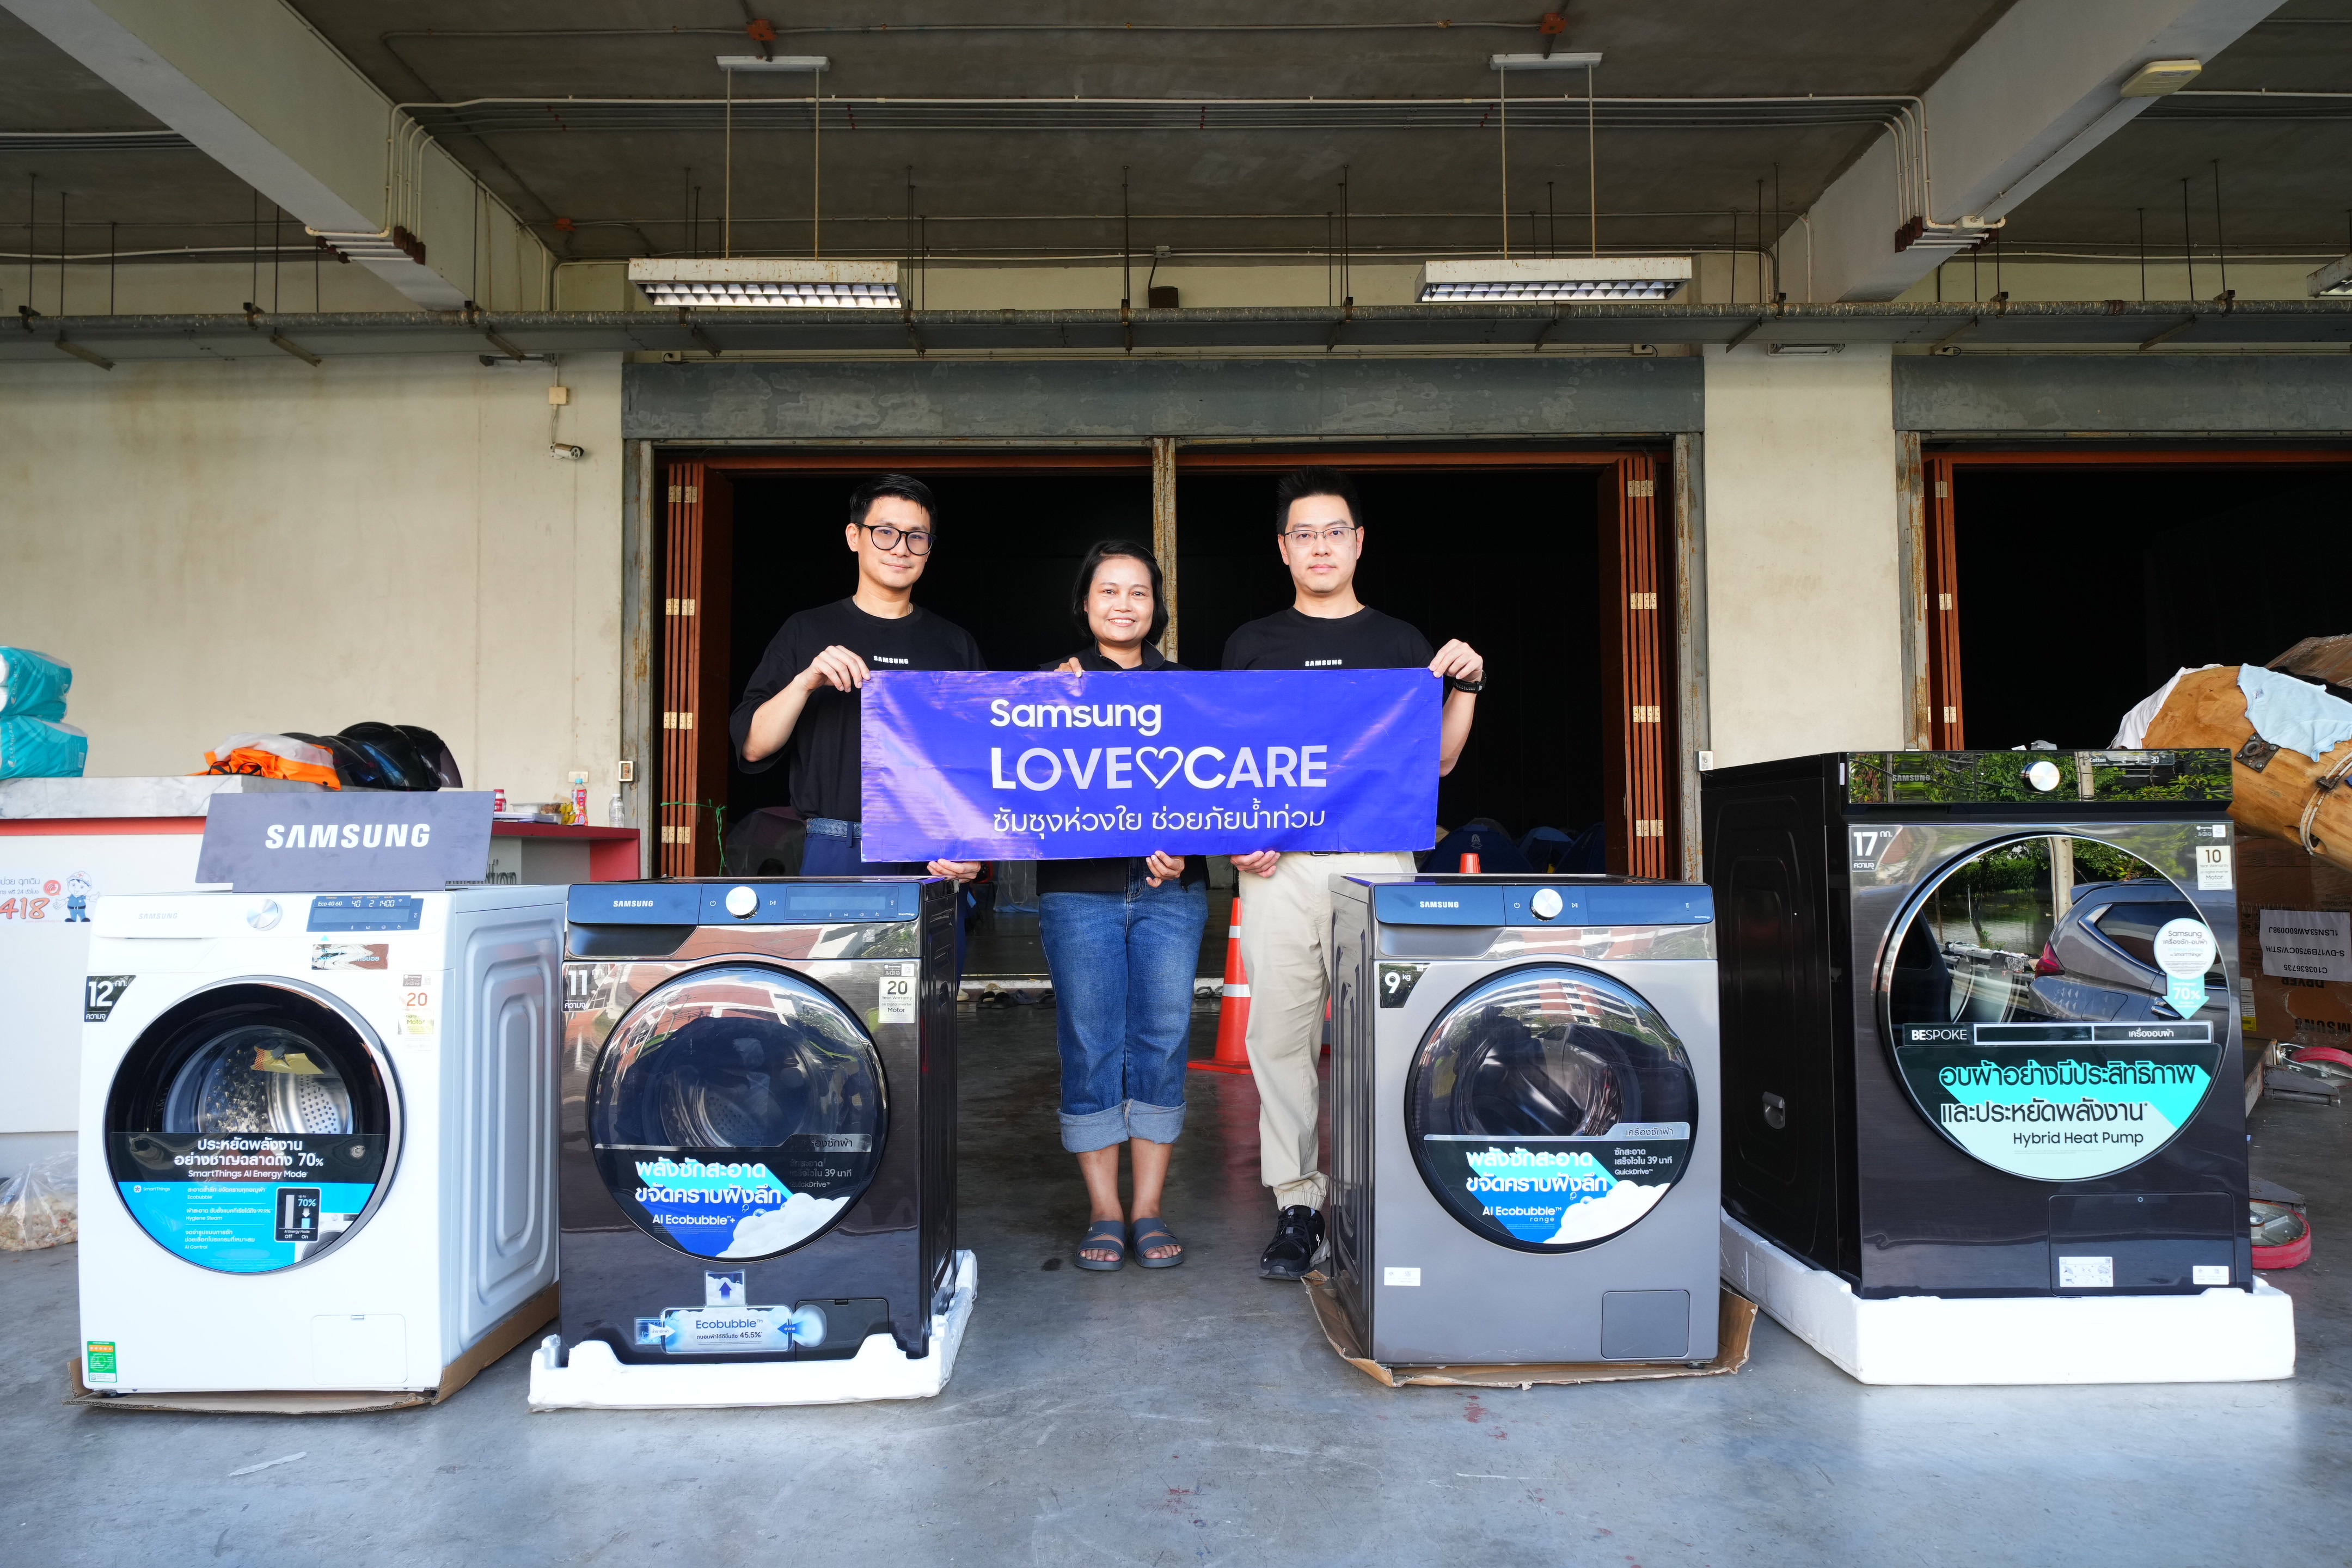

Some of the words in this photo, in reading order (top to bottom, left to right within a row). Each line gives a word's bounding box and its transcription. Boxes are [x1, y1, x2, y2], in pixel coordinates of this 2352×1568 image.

[873, 656, 909, 664] SAMSUNG
[990, 699, 1161, 737] Samsung
[991, 746, 1132, 792] LOVE
[1184, 745, 1327, 789] CARE
[994, 805, 1142, 839] ซัมซุงห่วงใย
[1152, 798, 1325, 831] ช่วยภัยน้ำท่วม
[265, 823, 430, 849] SAMSUNG
[1853, 831, 1878, 856] 17
[2206, 849, 2221, 863] 10
[0, 876, 15, 885] ป่วย
[138, 912, 177, 921] SAMSUNG
[2168, 930, 2202, 939] Samsung
[2283, 964, 2328, 973] C103836735
[568, 970, 587, 995] 11
[887, 981, 908, 995] 20
[1385, 972, 1401, 994] 9
[1402, 973, 1411, 982] kg
[89, 981, 113, 1007] 12
[407, 993, 427, 1006] 20
[2172, 987, 2201, 1000] 70%
[85, 1013, 106, 1021] ความจุ
[1912, 1030, 1967, 1040] BESPOKE
[2128, 1027, 2174, 1038] เครื่องอบผ้า
[1939, 1059, 2195, 1086] อบผ้าอย่างมีประสิทธิภาพ
[1625, 1125, 1674, 1137] เครื่องซักผ้า
[198, 1137, 302, 1151] ประหยัดพลังงาน
[802, 1137, 853, 1148] รื่องซักผ้า
[2013, 1132, 2061, 1148] Hybrid
[2065, 1132, 2099, 1144] Heat
[2103, 1132, 2143, 1146] Pump
[1466, 1147, 1592, 1167] พลังซักสะอาด
[1614, 1147, 1646, 1155] ซักสะอาด
[174, 1152, 292, 1166] อย่างชาญฉลาดถึง
[1614, 1156, 1645, 1165] เสร็จไวใน
[1647, 1156, 1657, 1165] 39
[1658, 1156, 1673, 1165] นาที
[635, 1156, 766, 1178] พลังซักสะอาด
[825, 1169, 835, 1177] 39
[837, 1169, 852, 1177] นาที
[188, 1170, 242, 1178] SmartThings
[253, 1170, 282, 1180] Energy
[1466, 1172, 1607, 1192] ขจัดคราบฝังลึก
[635, 1183, 781, 1204] ขจัดคราบฝังลึก
[1483, 1206, 1493, 1215] AI
[1496, 1206, 1562, 1216] Ecobubble™
[653, 1215, 664, 1224] AI
[696, 1319, 763, 1330] Ecobubble™
